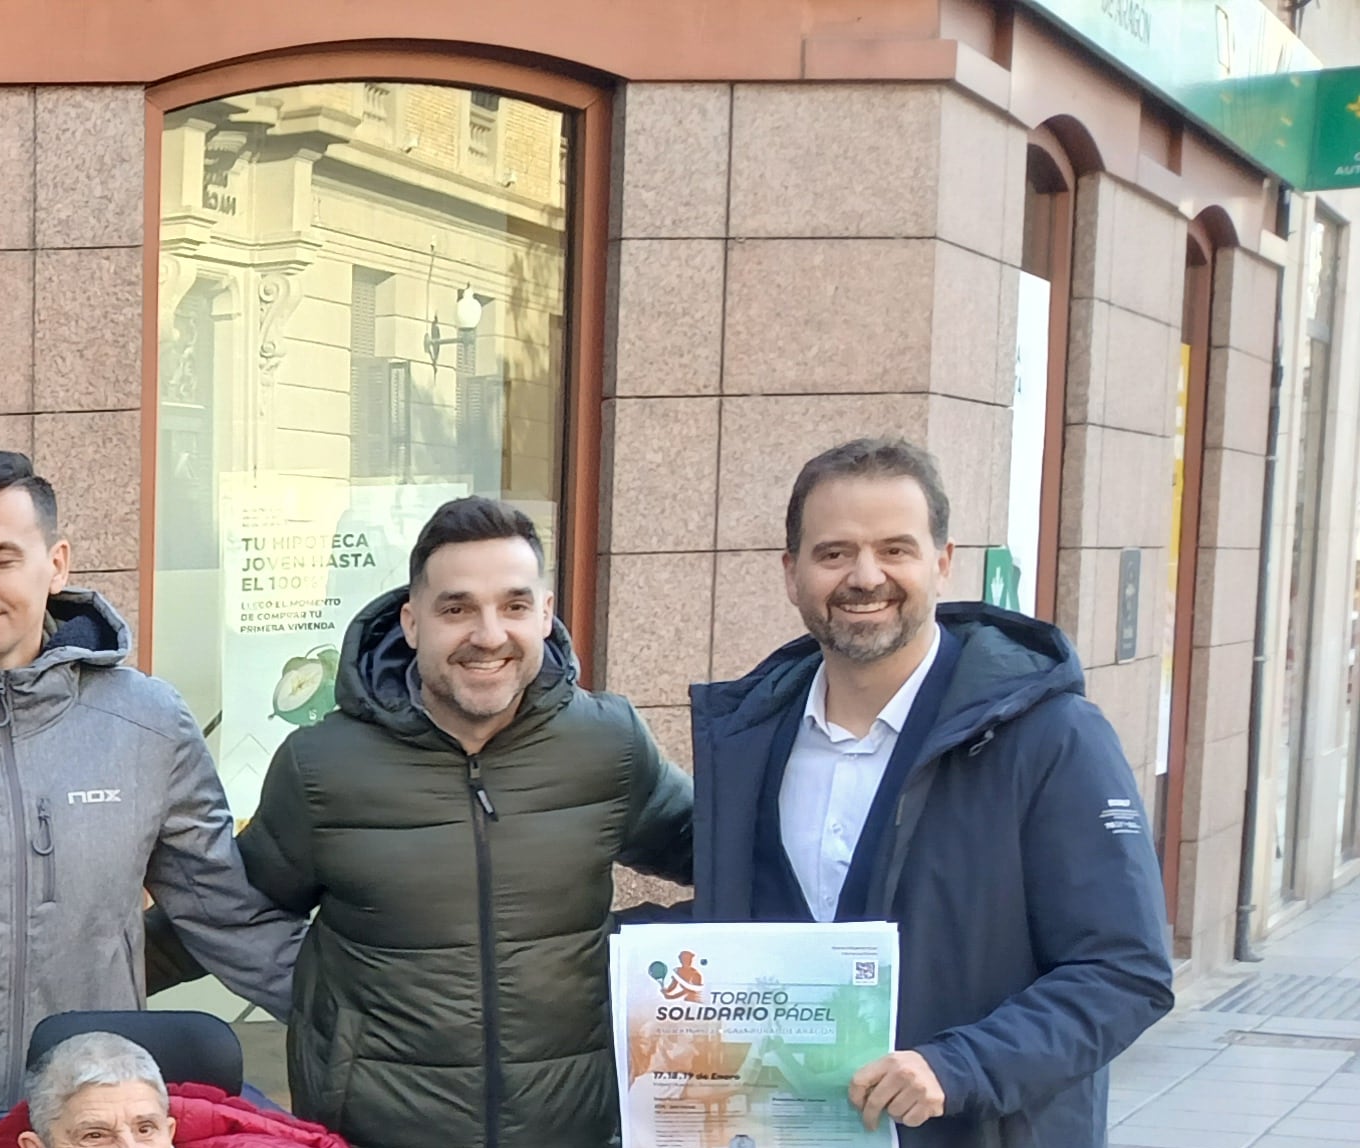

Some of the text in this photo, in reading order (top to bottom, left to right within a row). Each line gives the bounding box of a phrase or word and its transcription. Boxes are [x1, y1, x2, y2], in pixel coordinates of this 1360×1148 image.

[241, 533, 369, 551] TU HIPOTECA
[242, 552, 376, 572] JOVEN HASTA
[241, 577, 264, 592] EL
[710, 991, 789, 1005] TORNEO
[656, 1004, 835, 1022] SOLIDARIO PÁDEL
